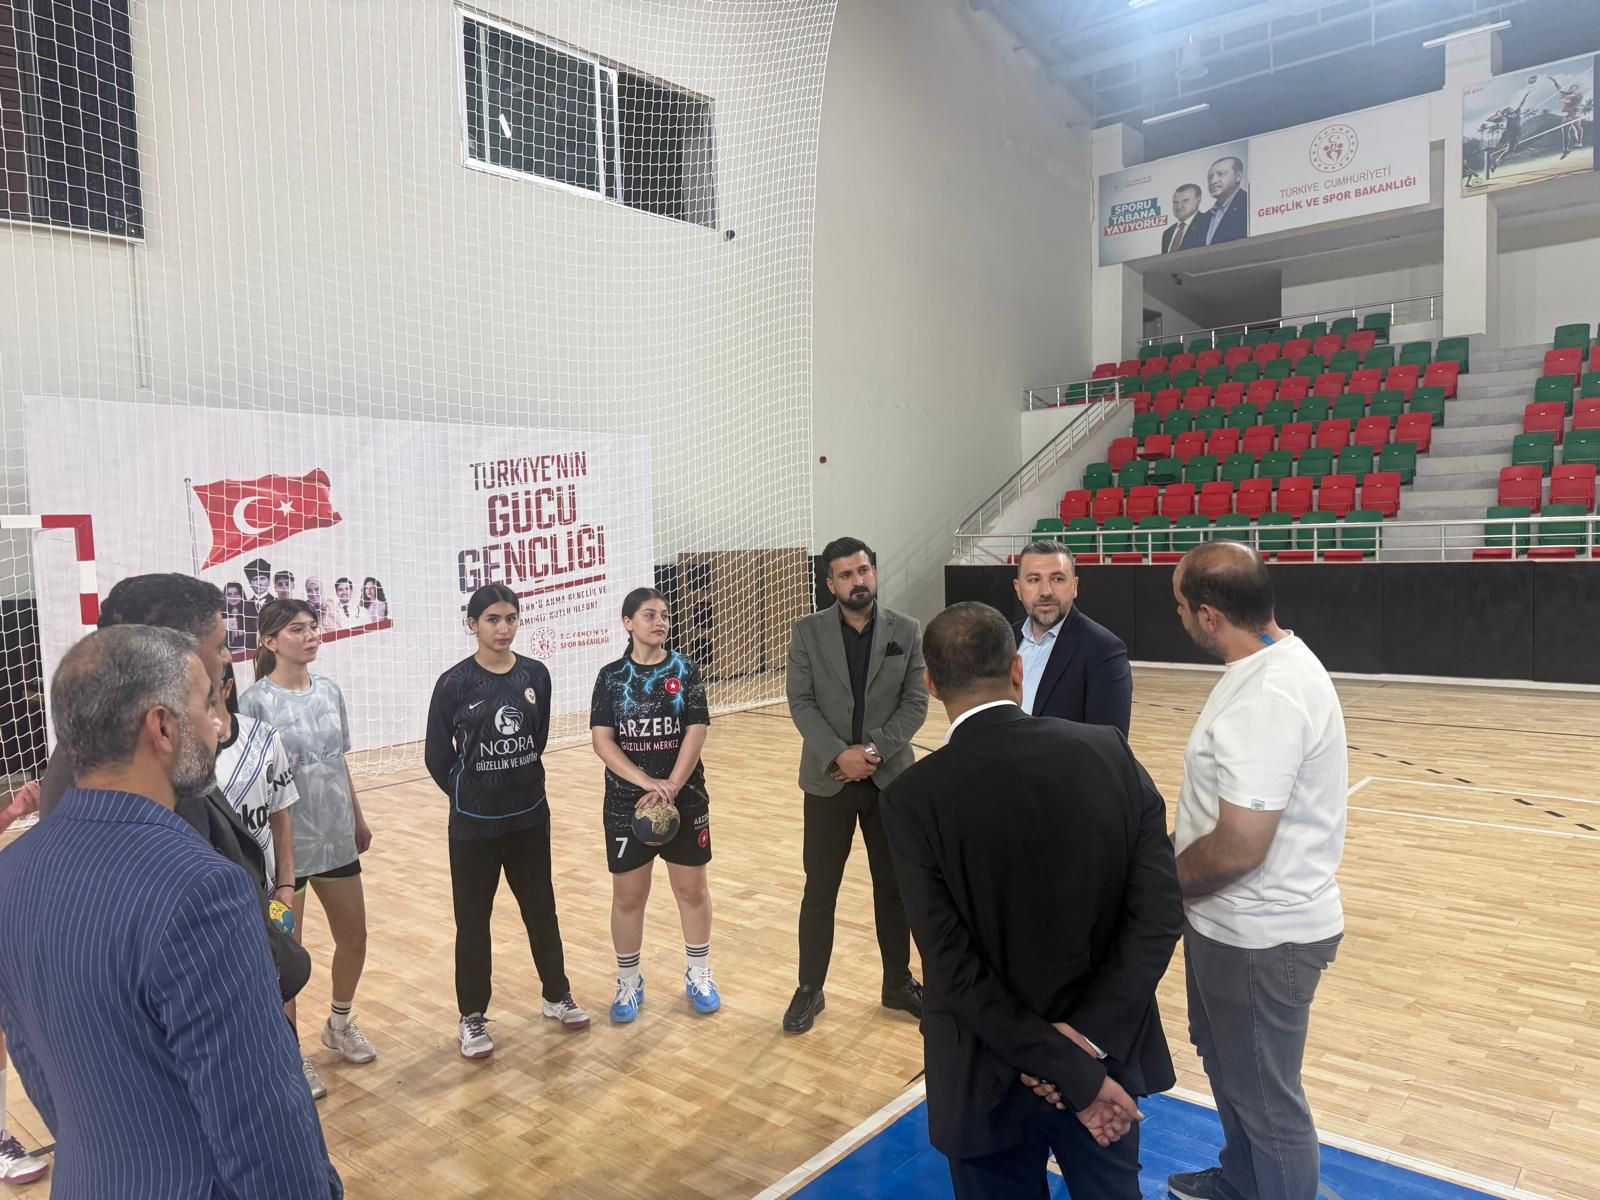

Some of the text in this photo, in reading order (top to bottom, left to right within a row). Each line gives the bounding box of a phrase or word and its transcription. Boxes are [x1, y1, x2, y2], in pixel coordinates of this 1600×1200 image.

[1280, 165, 1391, 199] TÜRKİYE CUMHURİYETİ
[1115, 200, 1152, 214] SPORU
[1257, 175, 1417, 218] GENÇLİK VE SPOR BAKANLIĞI
[1105, 216, 1167, 236] YAYIYORUZ
[1112, 208, 1157, 225] TABANA
[469, 451, 587, 491] TÜRKİYE'NİN
[488, 484, 577, 537] GÜCÜ
[458, 524, 606, 594] GENÇLİĞİ
[619, 716, 681, 737] ARZEBA
[480, 735, 535, 757] NOORA
[476, 758, 510, 771] GÜZELLİK
[510, 757, 519, 768] VE
[615, 837, 629, 859] 7
